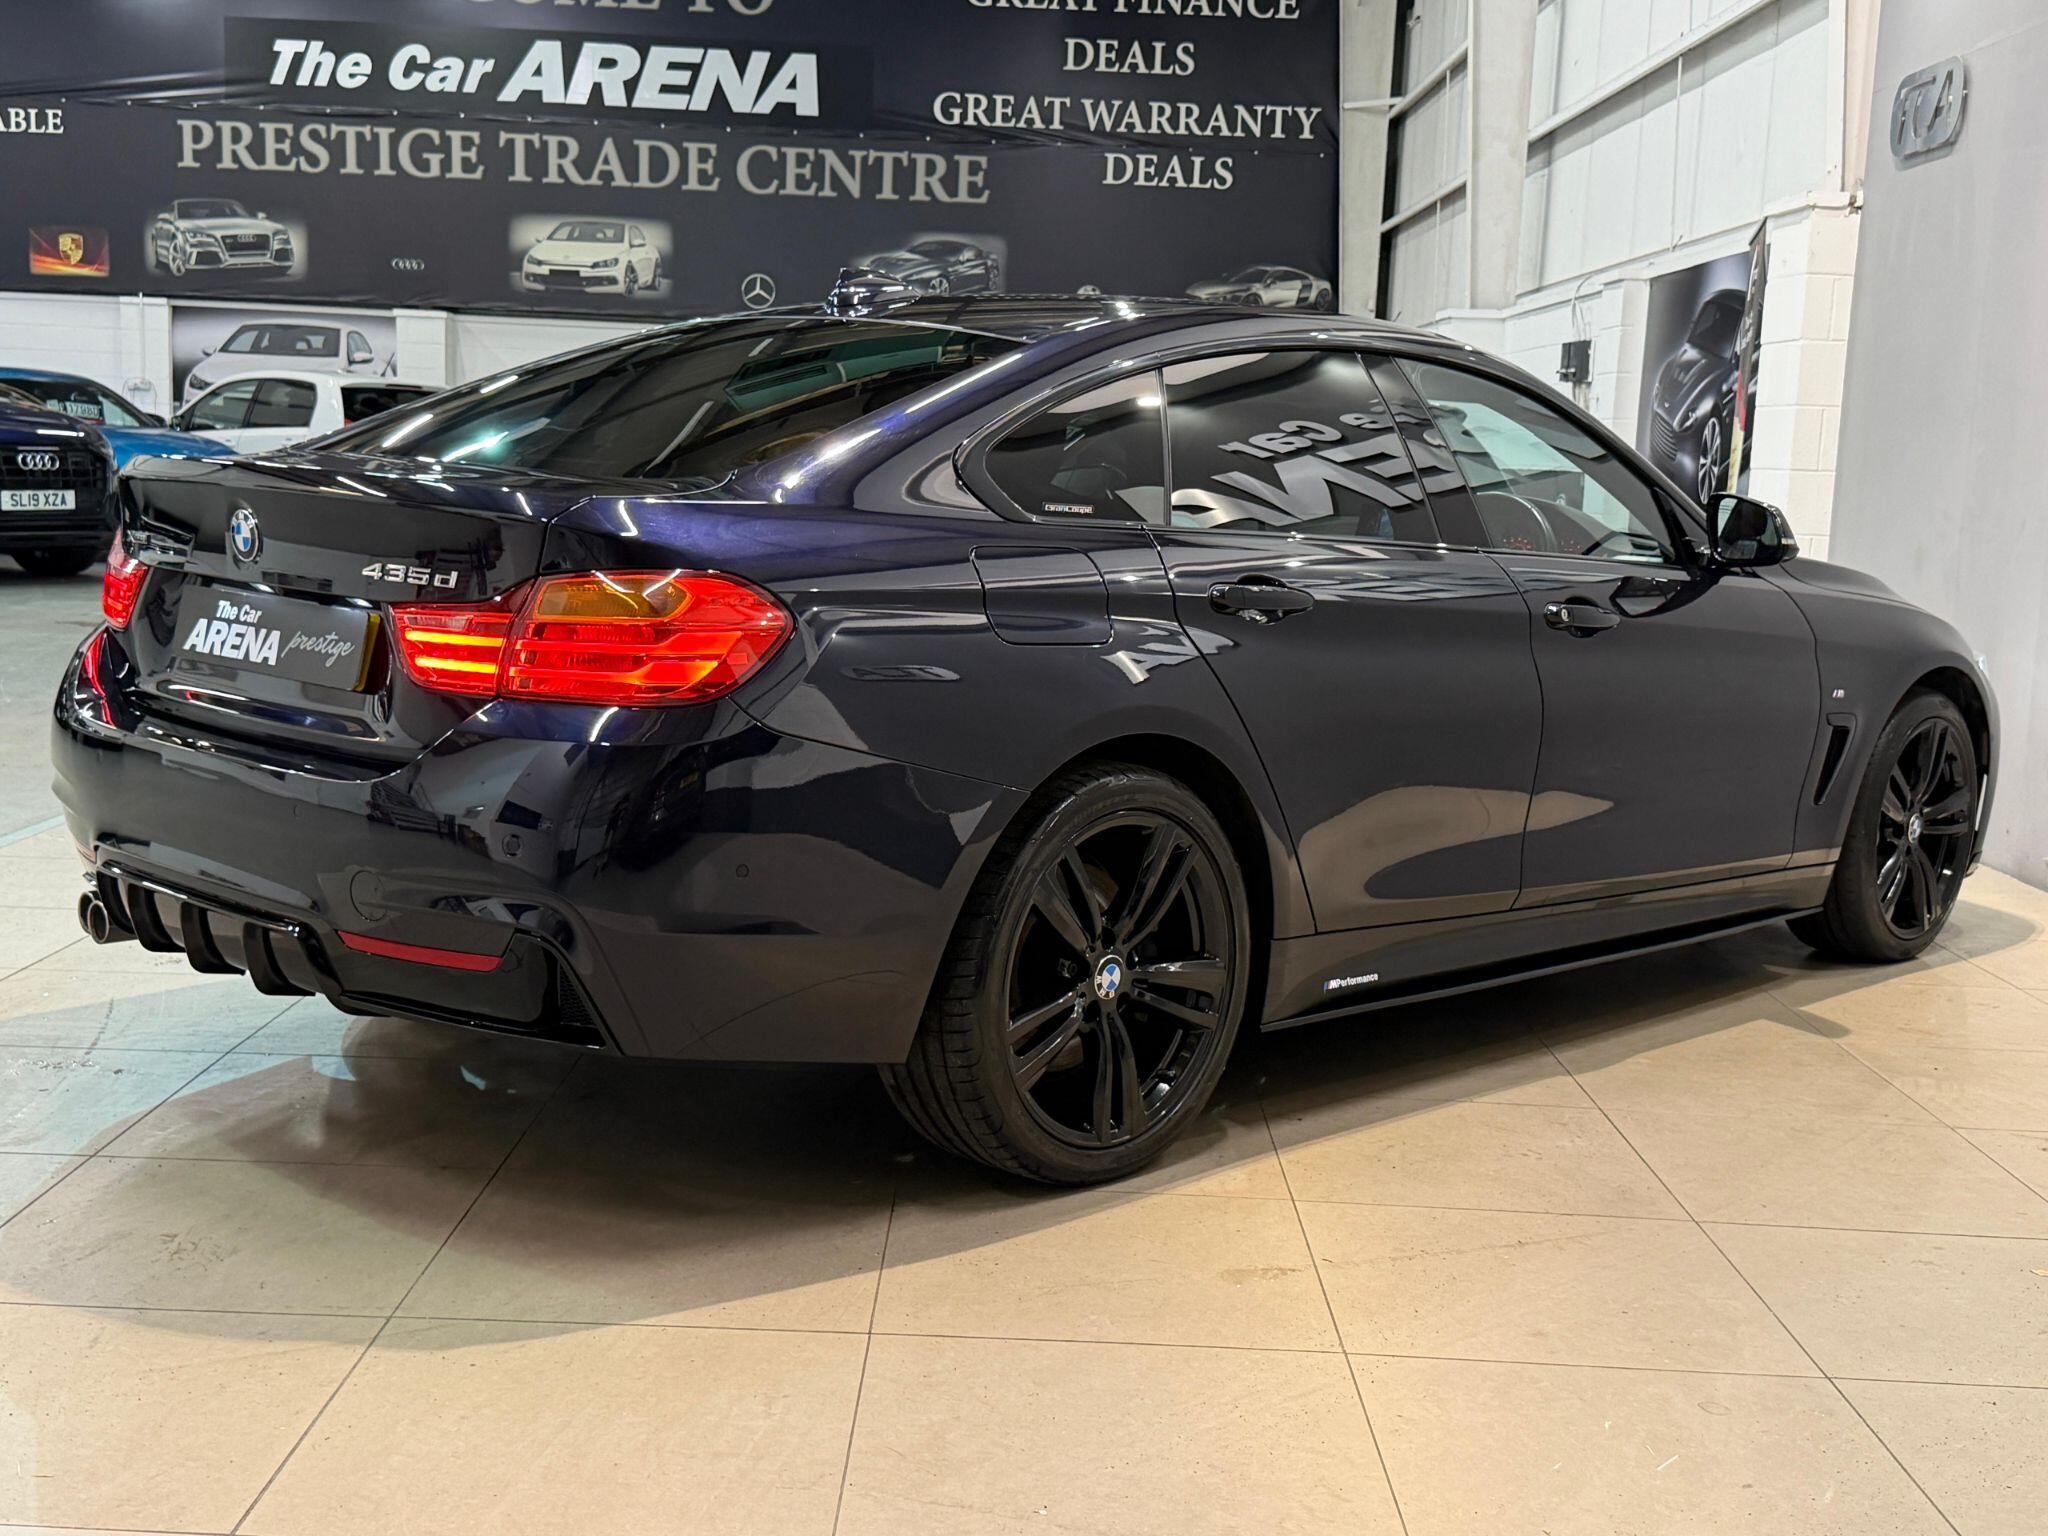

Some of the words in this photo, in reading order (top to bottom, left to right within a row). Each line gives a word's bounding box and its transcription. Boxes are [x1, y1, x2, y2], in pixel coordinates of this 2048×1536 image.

[1062, 38, 1195, 76] DEALS
[270, 38, 373, 89] The
[388, 43, 497, 94] Car
[497, 39, 819, 117] ARENA
[933, 92, 1070, 130] GREAT
[1081, 99, 1322, 139] WARRANTY
[176, 119, 484, 180] PRESTIGE
[498, 130, 720, 191] TRADE
[736, 144, 990, 204] CENTRE
[1102, 152, 1233, 190] DEALS
[10, 493, 39, 508] SL19
[43, 493, 67, 507] XZA
[361, 562, 459, 589] 435d
[215, 599, 237, 620] The
[239, 604, 263, 624] Car
[182, 618, 281, 666] ARENA
[281, 631, 355, 668] prestige
